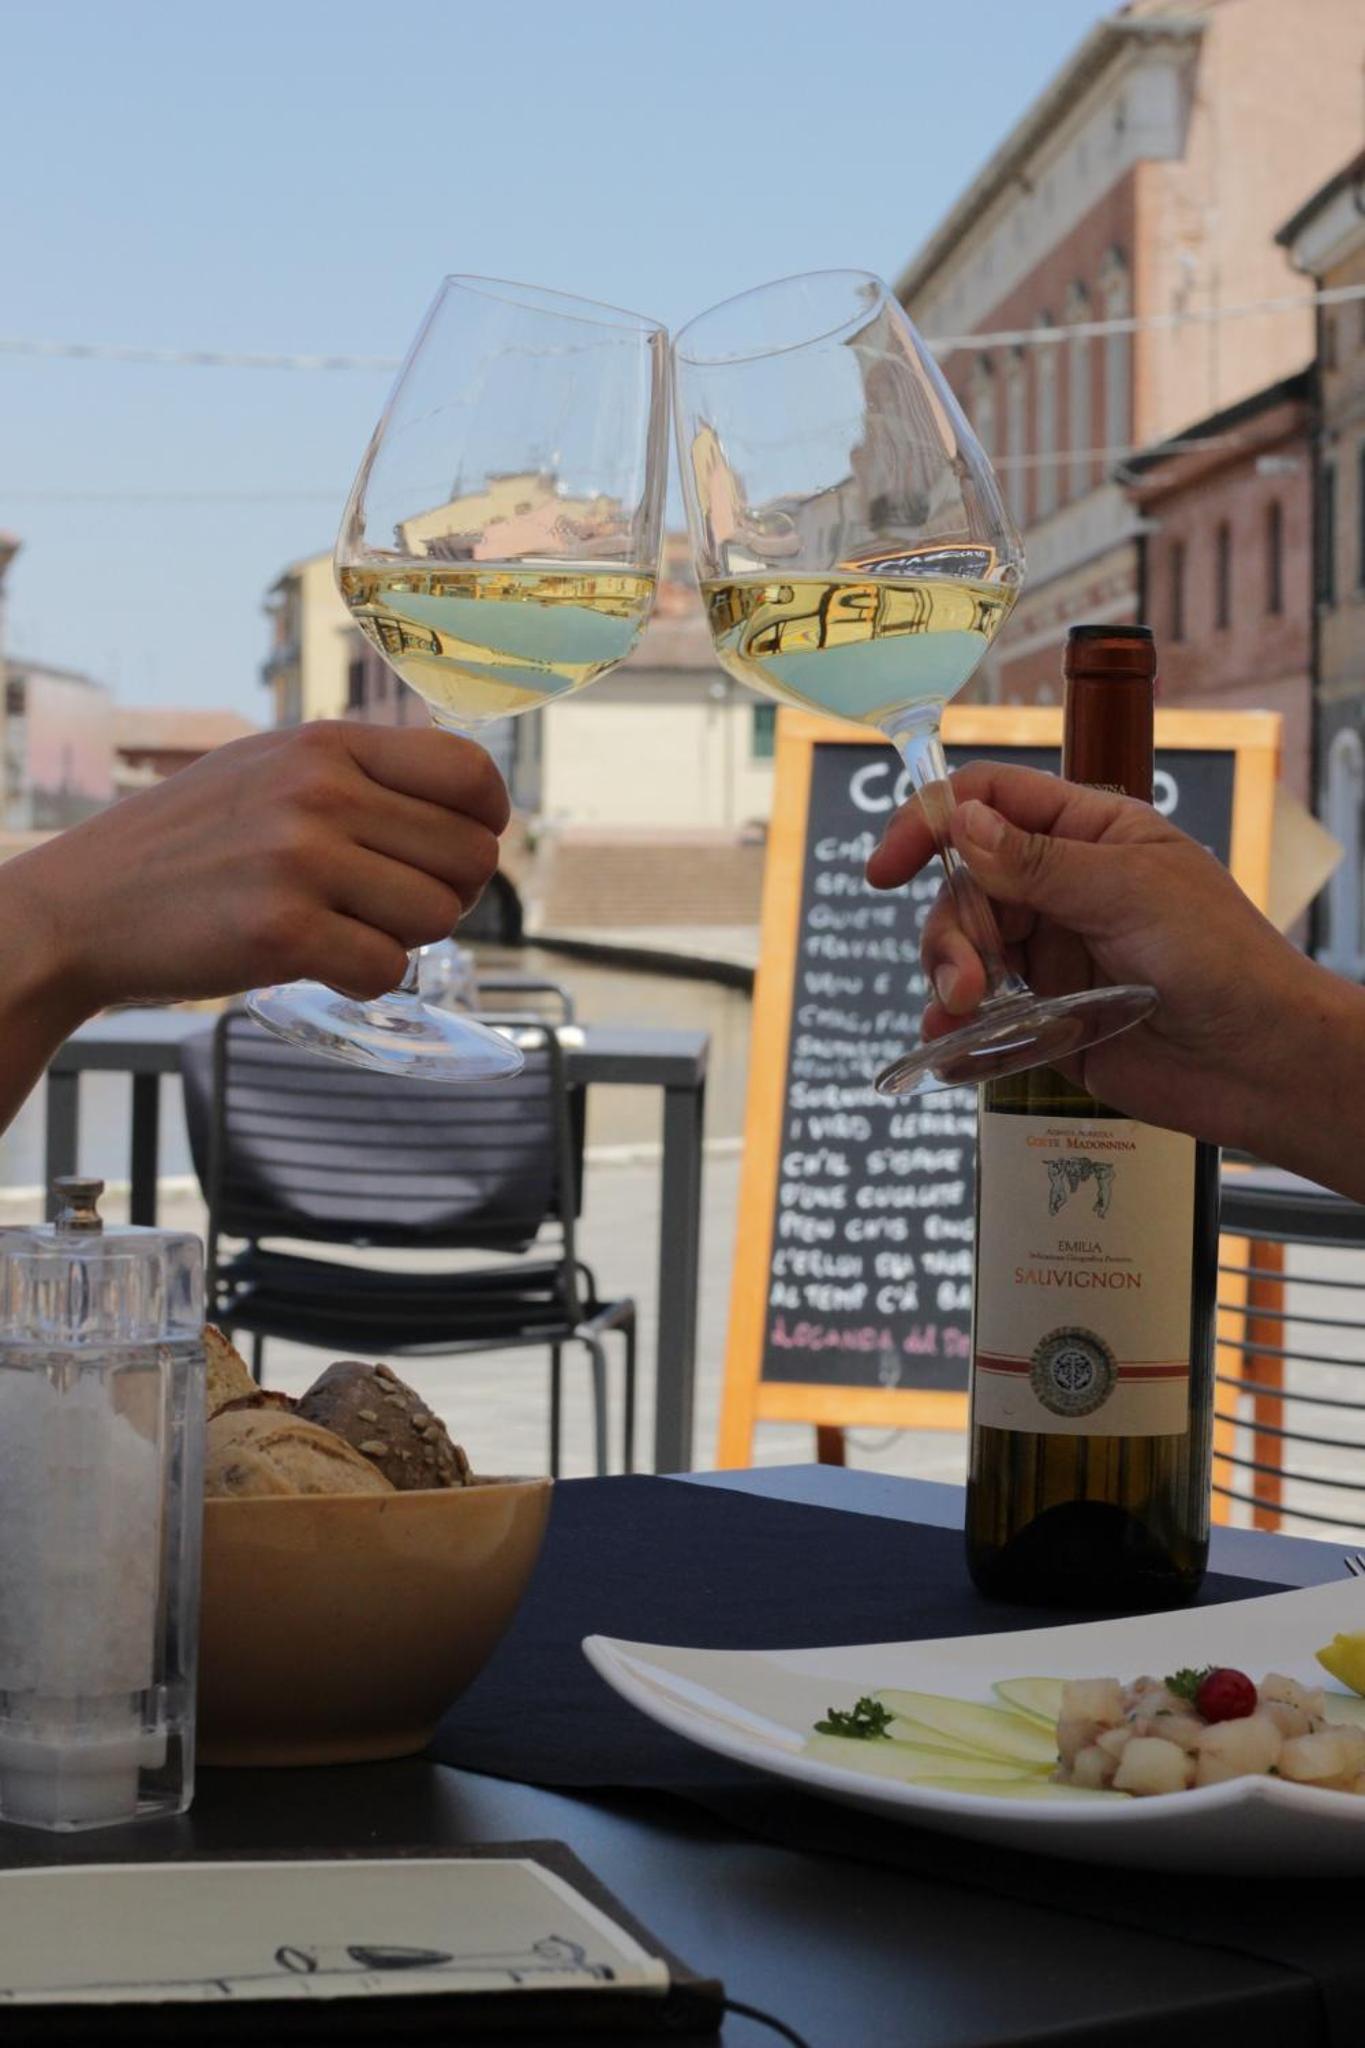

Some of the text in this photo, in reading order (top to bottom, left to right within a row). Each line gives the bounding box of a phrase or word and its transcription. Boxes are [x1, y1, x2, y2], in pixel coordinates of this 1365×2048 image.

[1066, 1137, 1137, 1150] MADONNINA
[1058, 1240, 1102, 1253] EMILIA
[1015, 1267, 1142, 1289] SAUVIGNON
